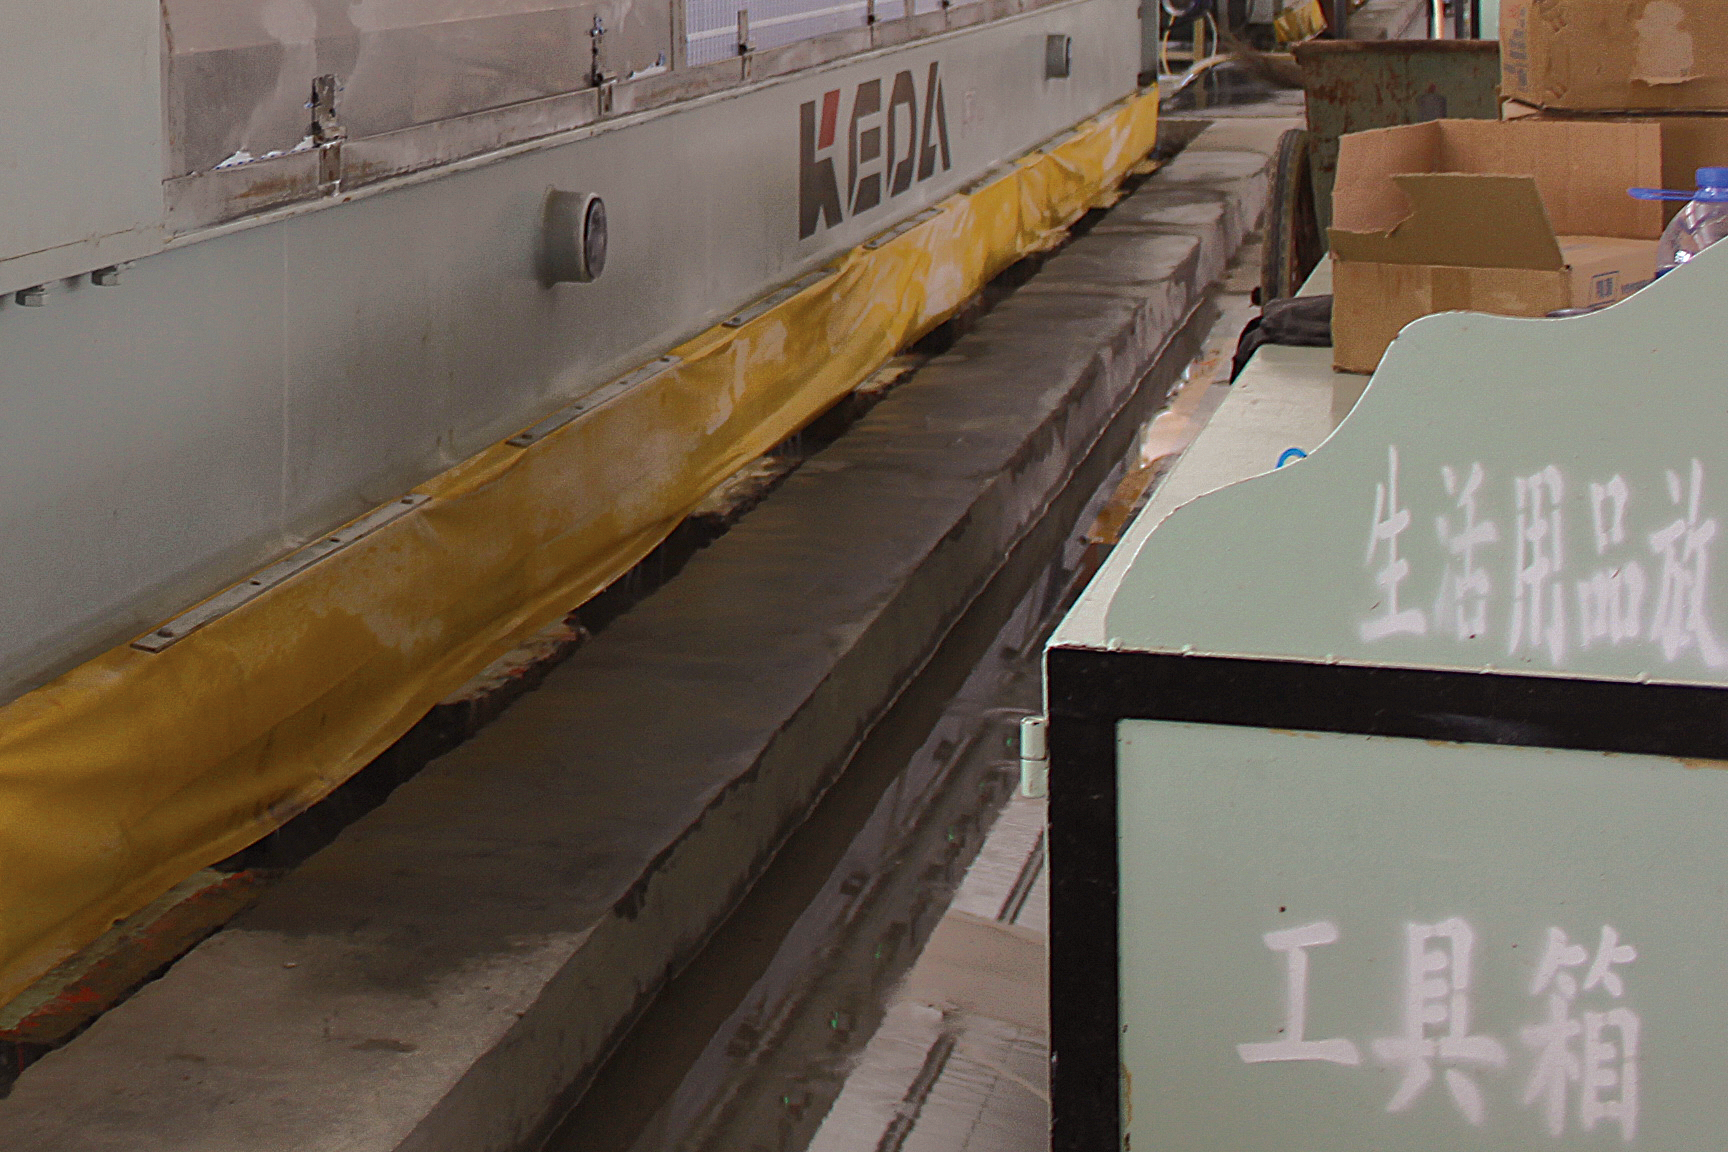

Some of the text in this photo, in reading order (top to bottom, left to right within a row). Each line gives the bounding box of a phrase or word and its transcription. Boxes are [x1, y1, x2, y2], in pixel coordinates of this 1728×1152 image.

[798, 61, 951, 242] KEDA
[1235, 915, 1639, 1143] 工具箱
